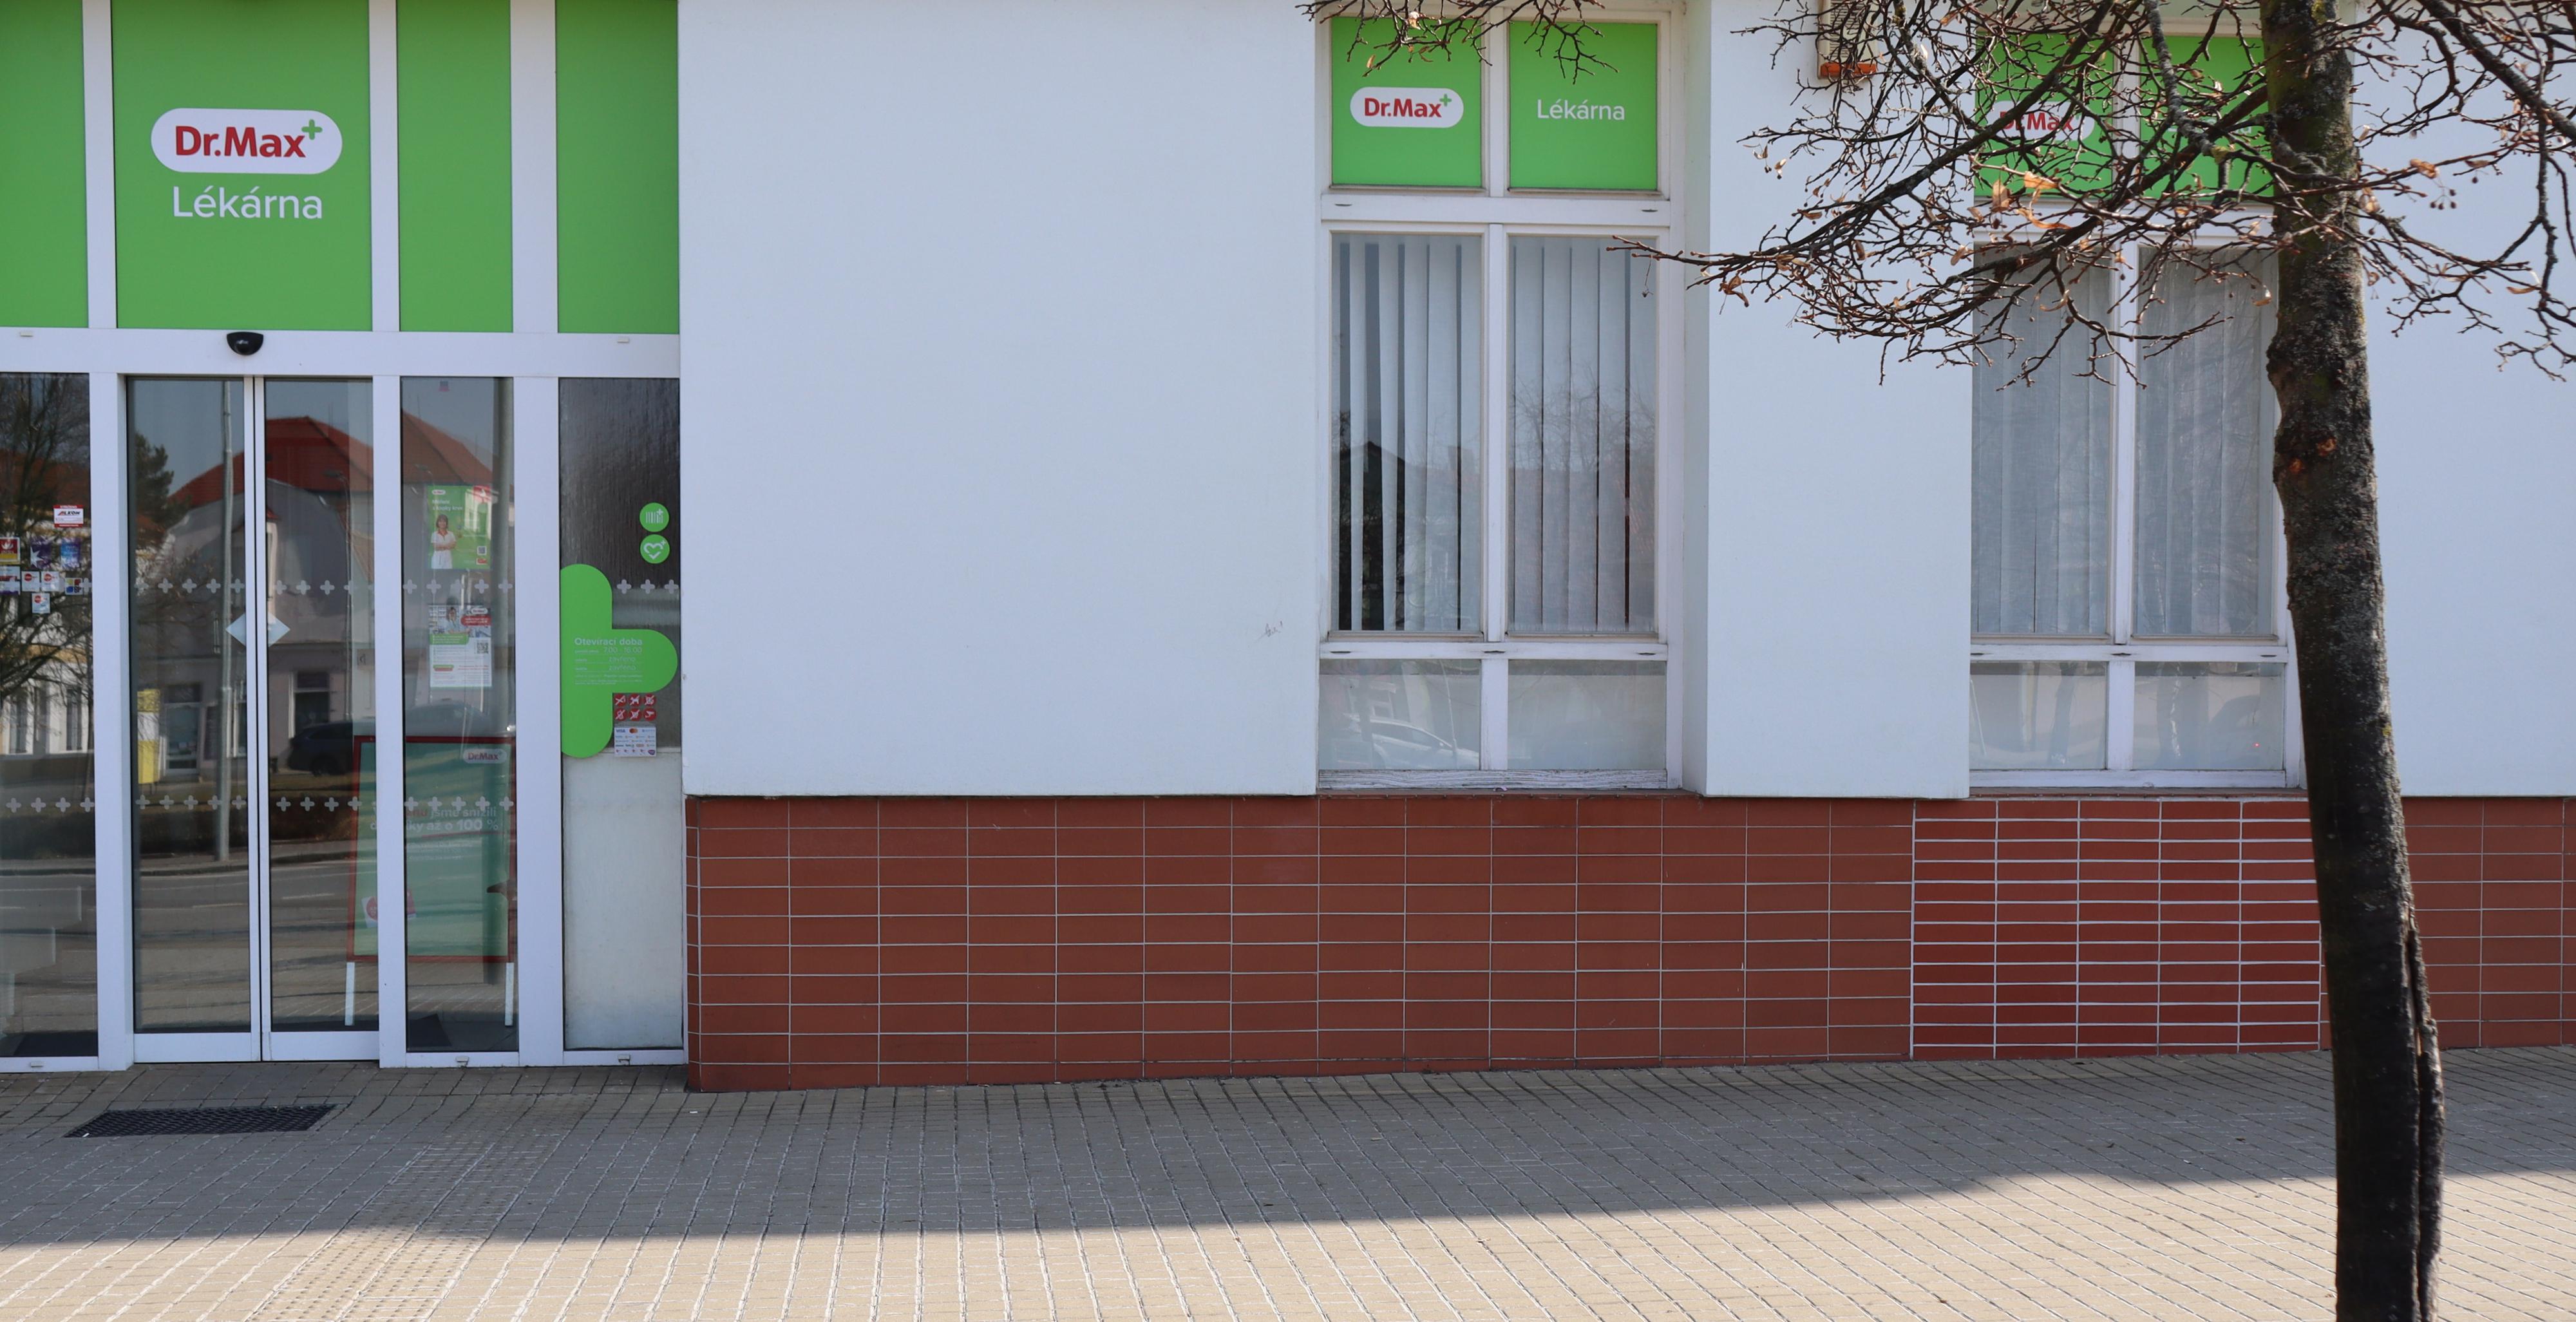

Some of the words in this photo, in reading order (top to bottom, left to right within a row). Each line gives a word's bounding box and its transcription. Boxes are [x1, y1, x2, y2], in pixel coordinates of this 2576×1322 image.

[1364, 97, 1441, 117] Dr.Max
[1537, 99, 1625, 120] Lékárna
[175, 126, 305, 158] Dr.Max
[173, 185, 323, 220] Lékárna
[619, 637, 643, 645] doba
[444, 822, 453, 831] o
[457, 818, 483, 831] 100
